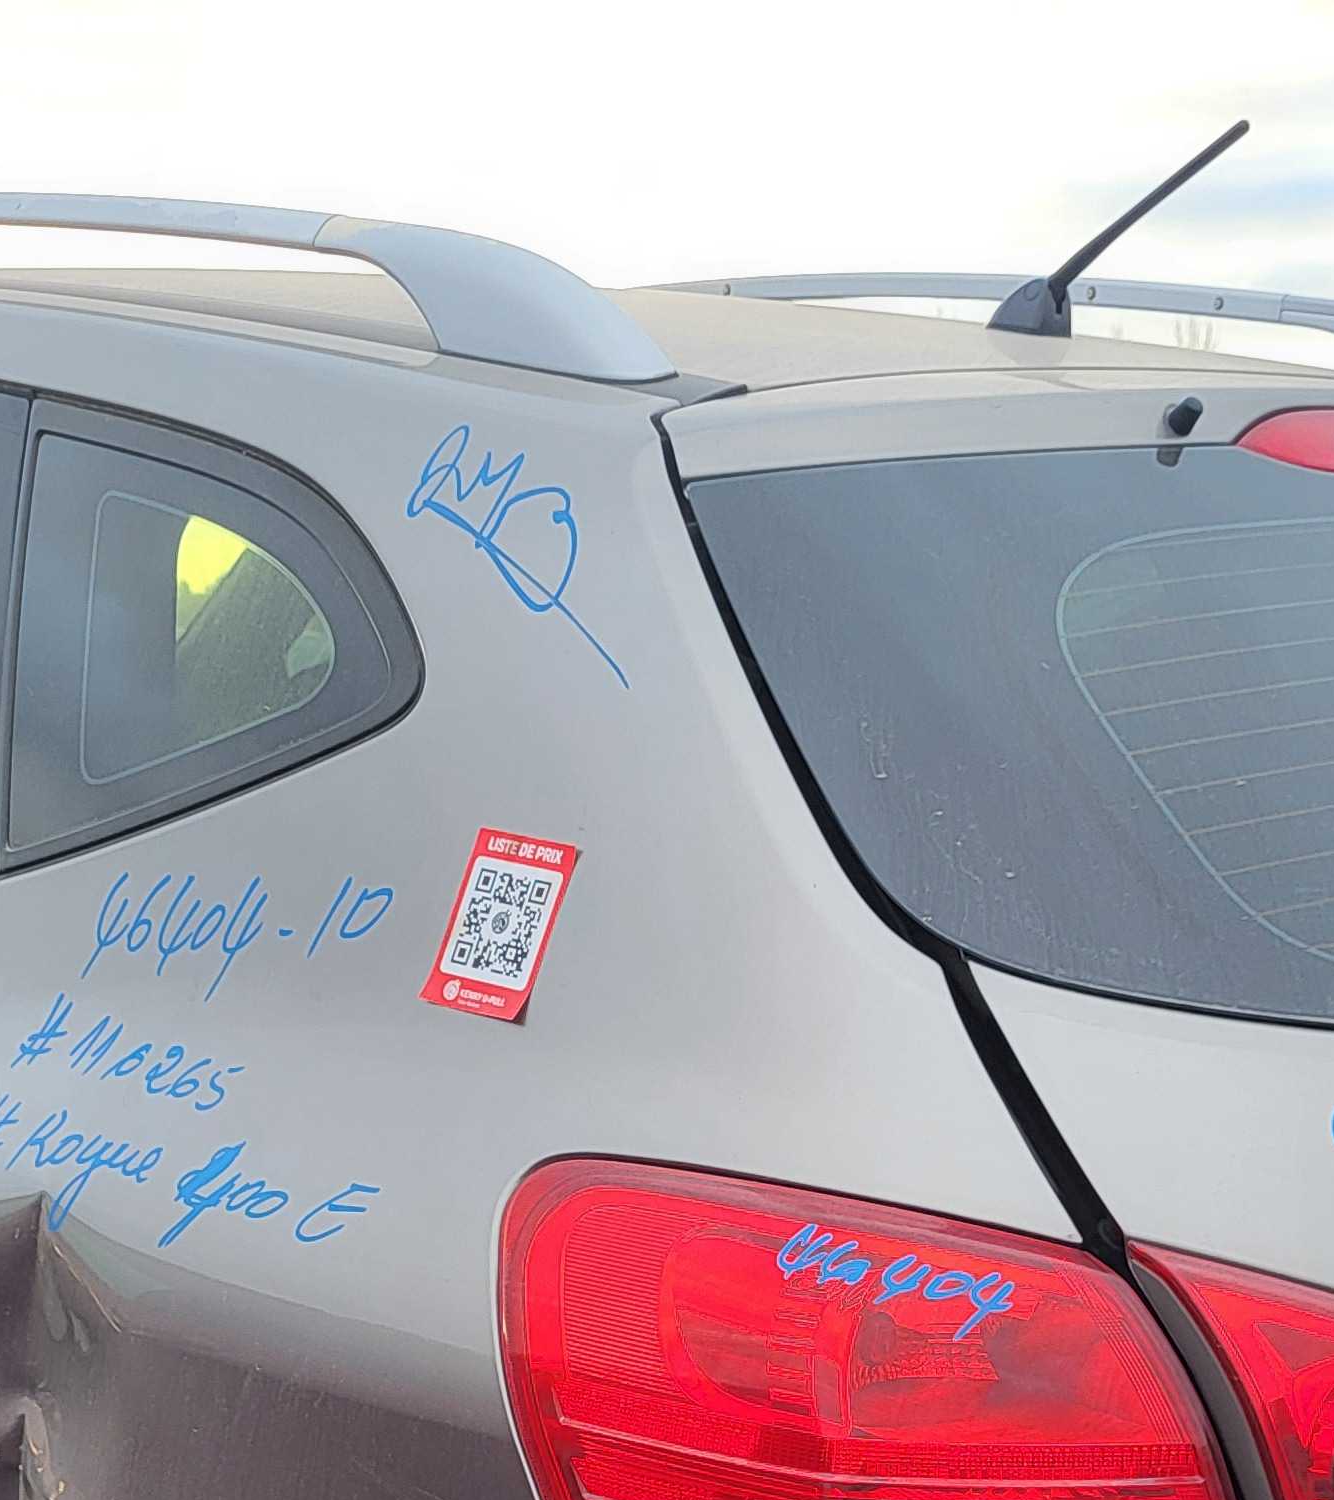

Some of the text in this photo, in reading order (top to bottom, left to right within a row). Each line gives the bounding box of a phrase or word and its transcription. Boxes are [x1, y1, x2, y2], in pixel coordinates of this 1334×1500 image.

[487, 835, 564, 865] LISTE DE PRIX
